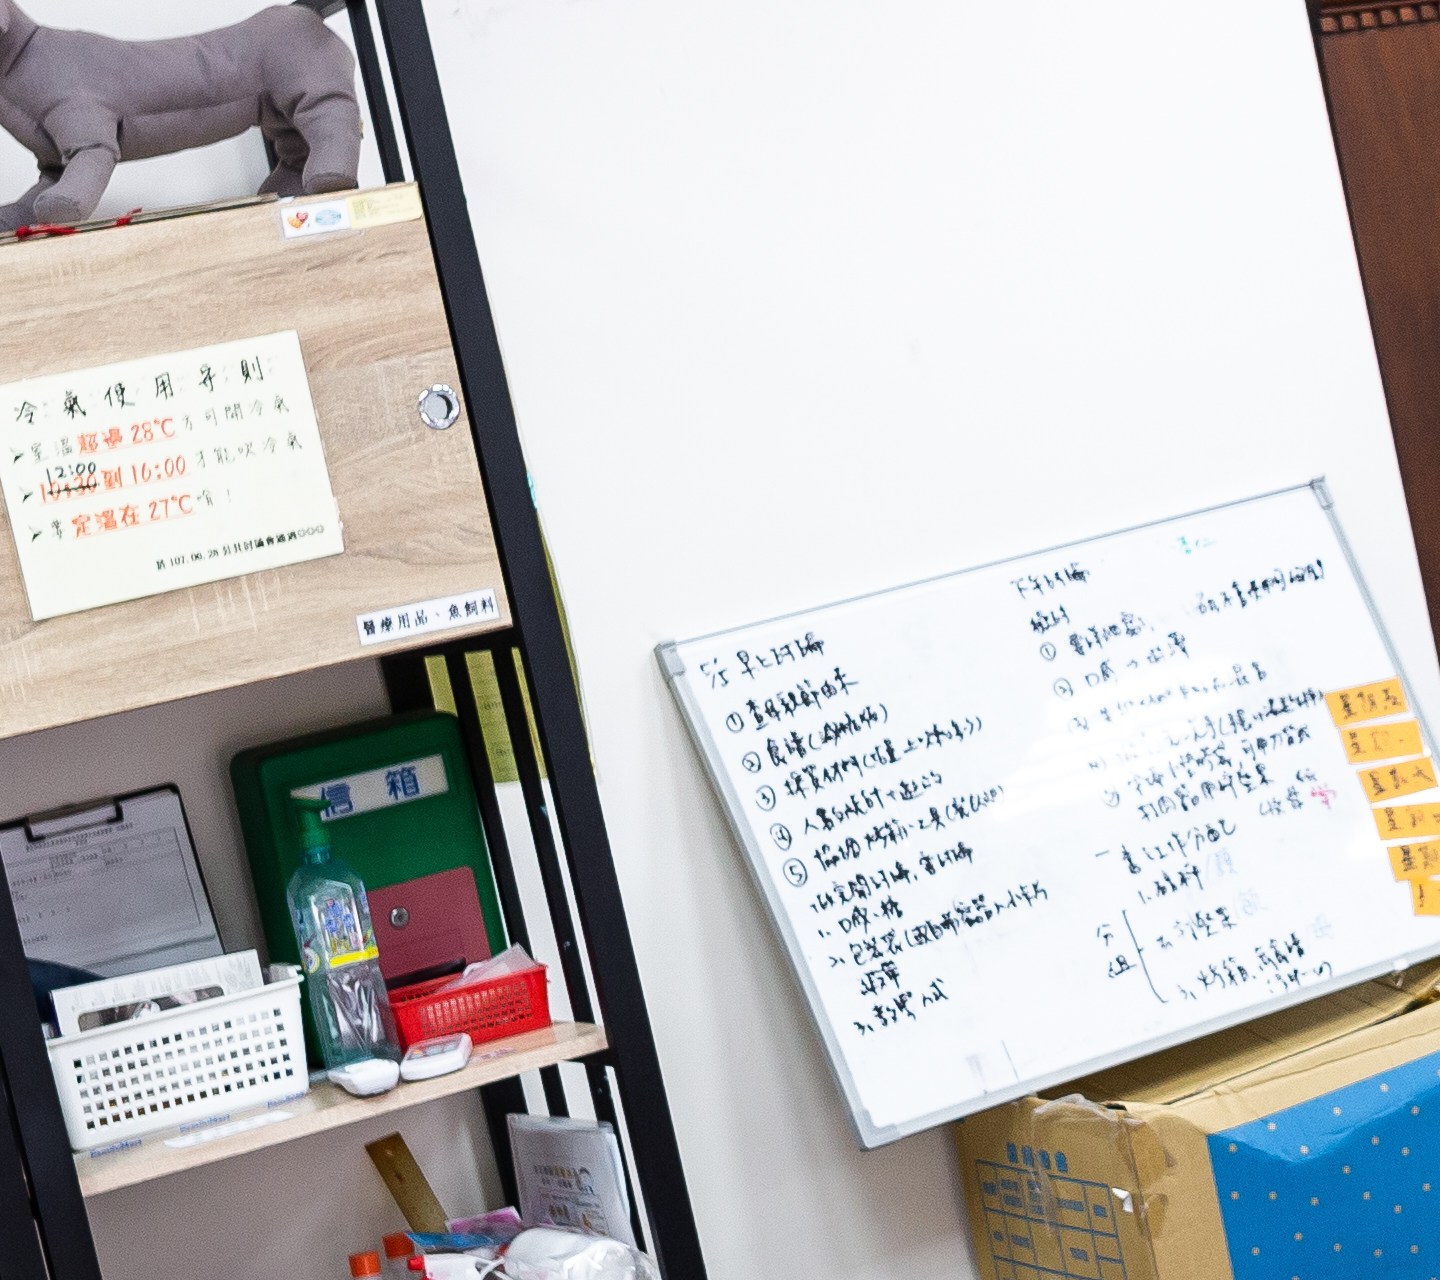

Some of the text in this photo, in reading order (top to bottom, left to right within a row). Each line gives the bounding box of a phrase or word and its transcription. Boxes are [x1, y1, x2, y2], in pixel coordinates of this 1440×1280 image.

[14, 356, 264, 425] 冷氣使用守則
[362, 595, 495, 637] 醫療用品、魚飼料
[320, 764, 421, 819] 信箱
